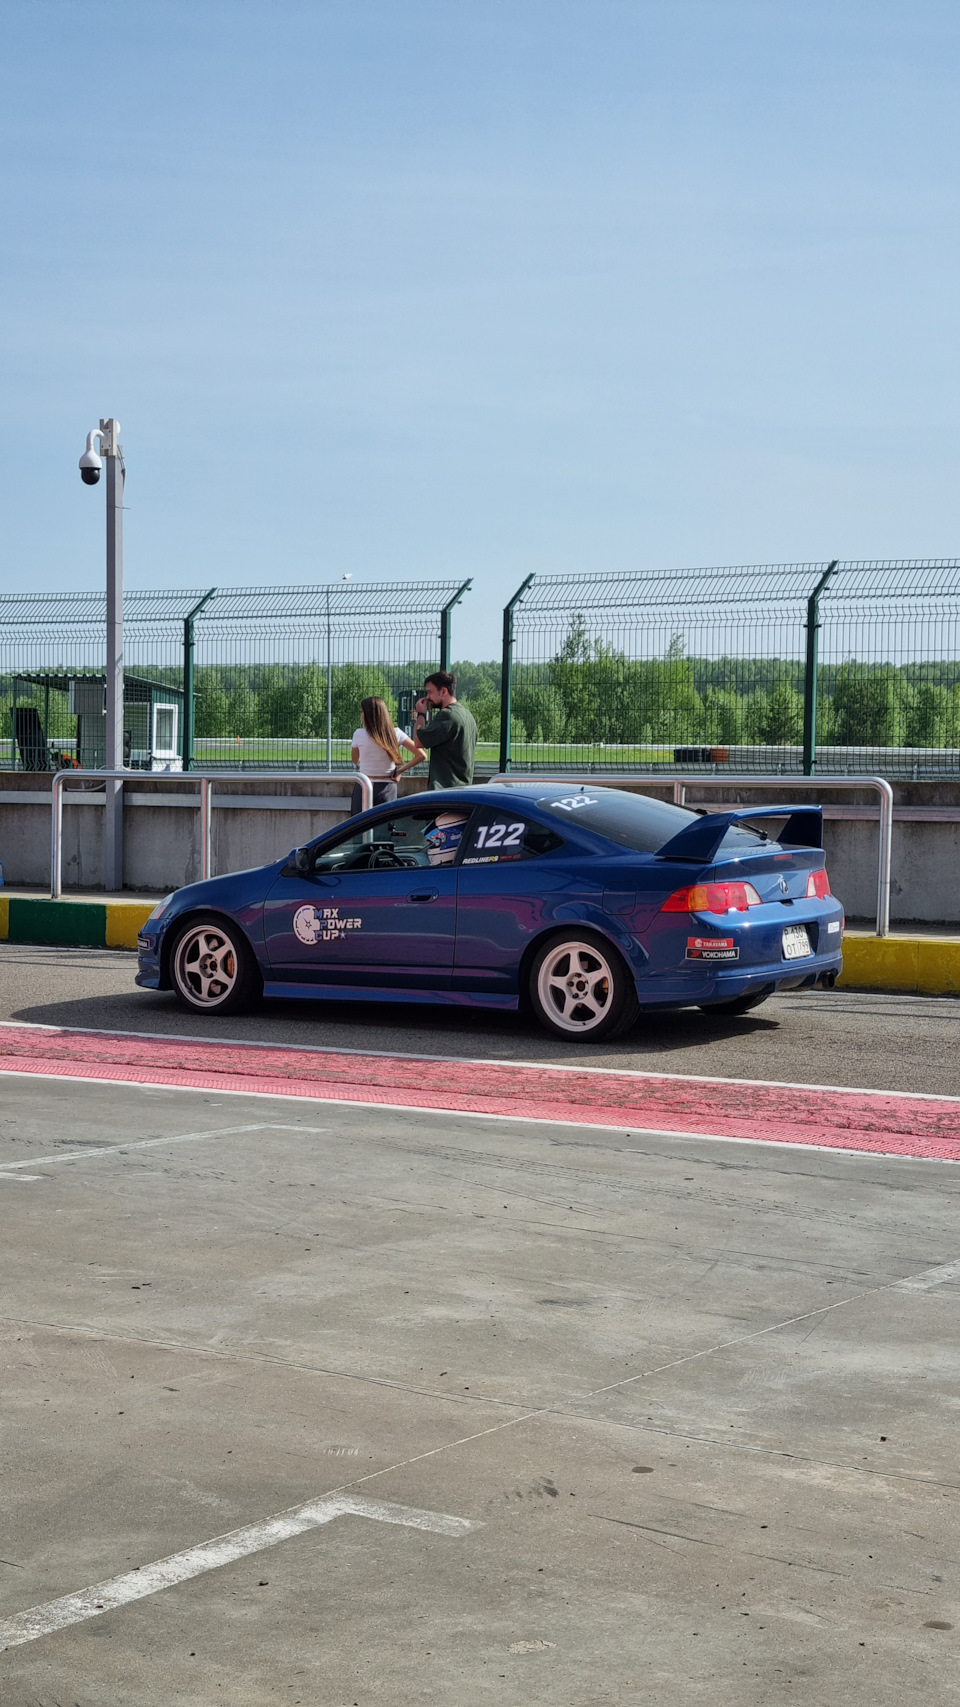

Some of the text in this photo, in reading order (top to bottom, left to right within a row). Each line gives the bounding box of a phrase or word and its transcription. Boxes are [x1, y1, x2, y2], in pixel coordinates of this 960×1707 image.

[550, 795, 599, 811] 122
[476, 823, 525, 848] 122
[314, 908, 339, 919] MAX
[320, 918, 361, 929] POWER
[315, 930, 339, 940] CUP
[701, 950, 736, 959] YOKOHAMA
